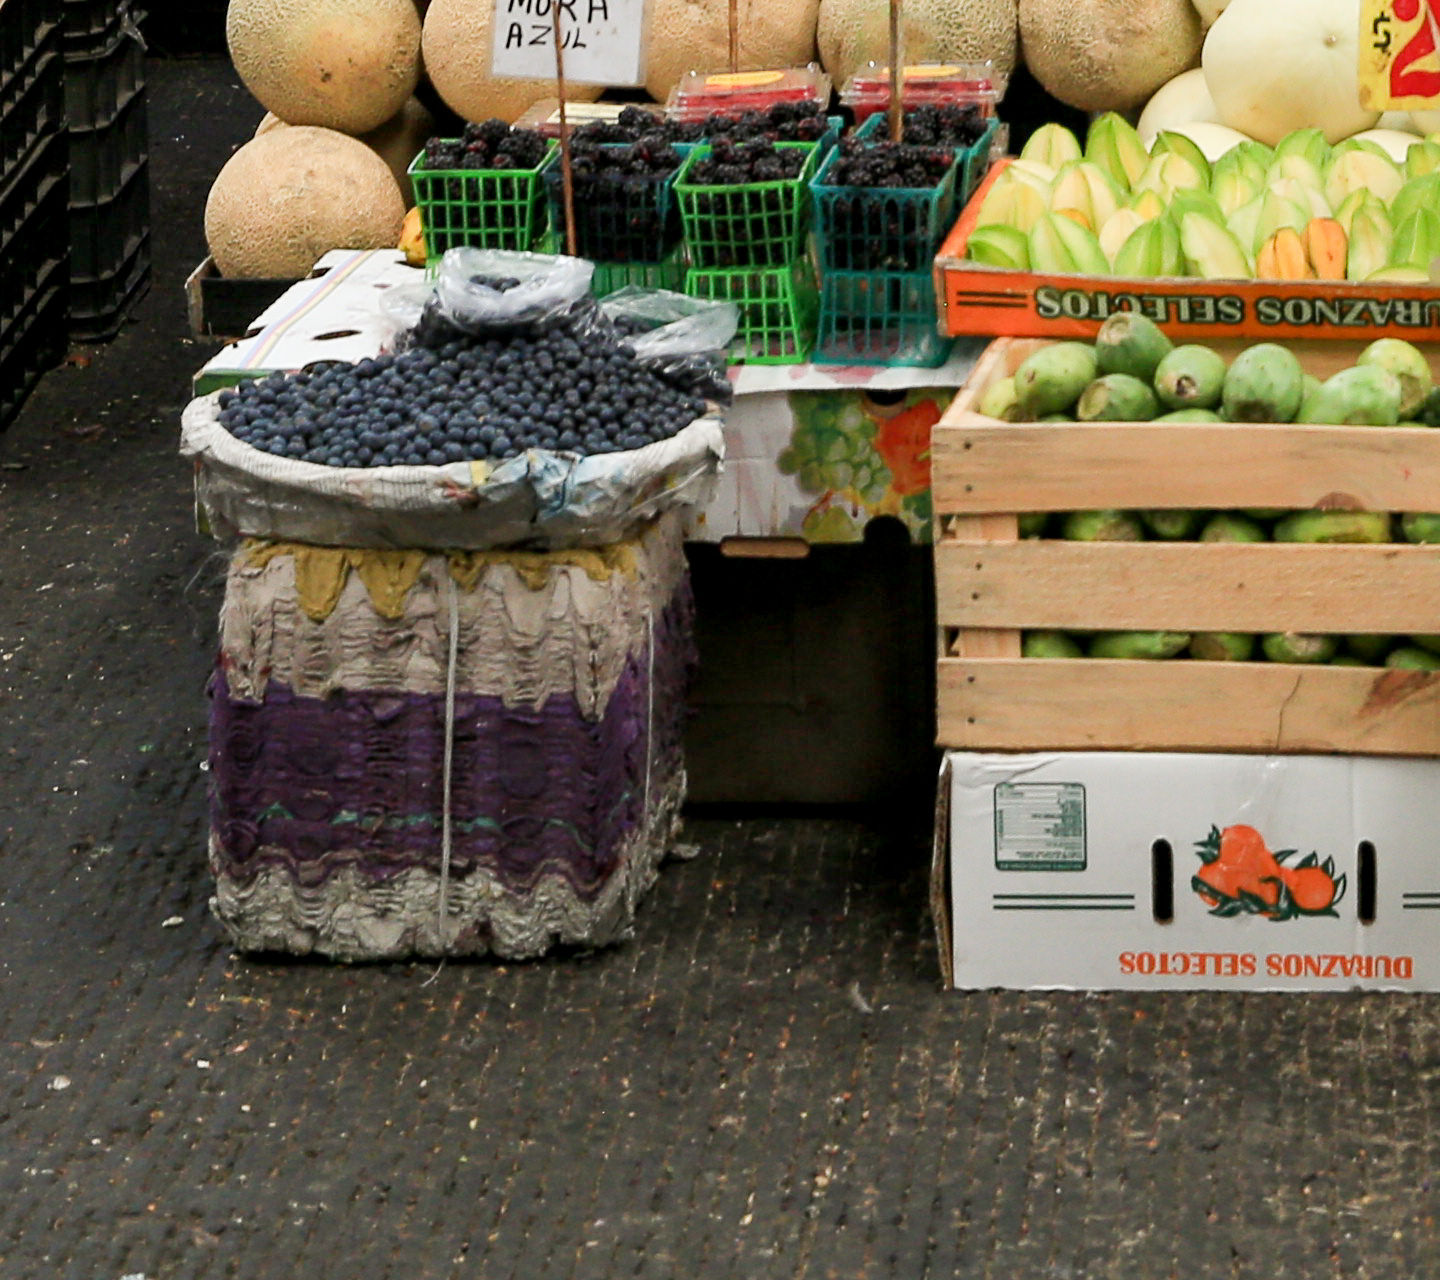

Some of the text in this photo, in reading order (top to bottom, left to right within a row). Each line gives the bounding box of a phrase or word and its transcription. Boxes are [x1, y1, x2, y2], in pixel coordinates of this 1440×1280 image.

[505, 23, 587, 50] AZUL
[1033, 285, 1245, 324] SELECTOS
[1119, 949, 1414, 980] DURAZNOS SELECTOS
